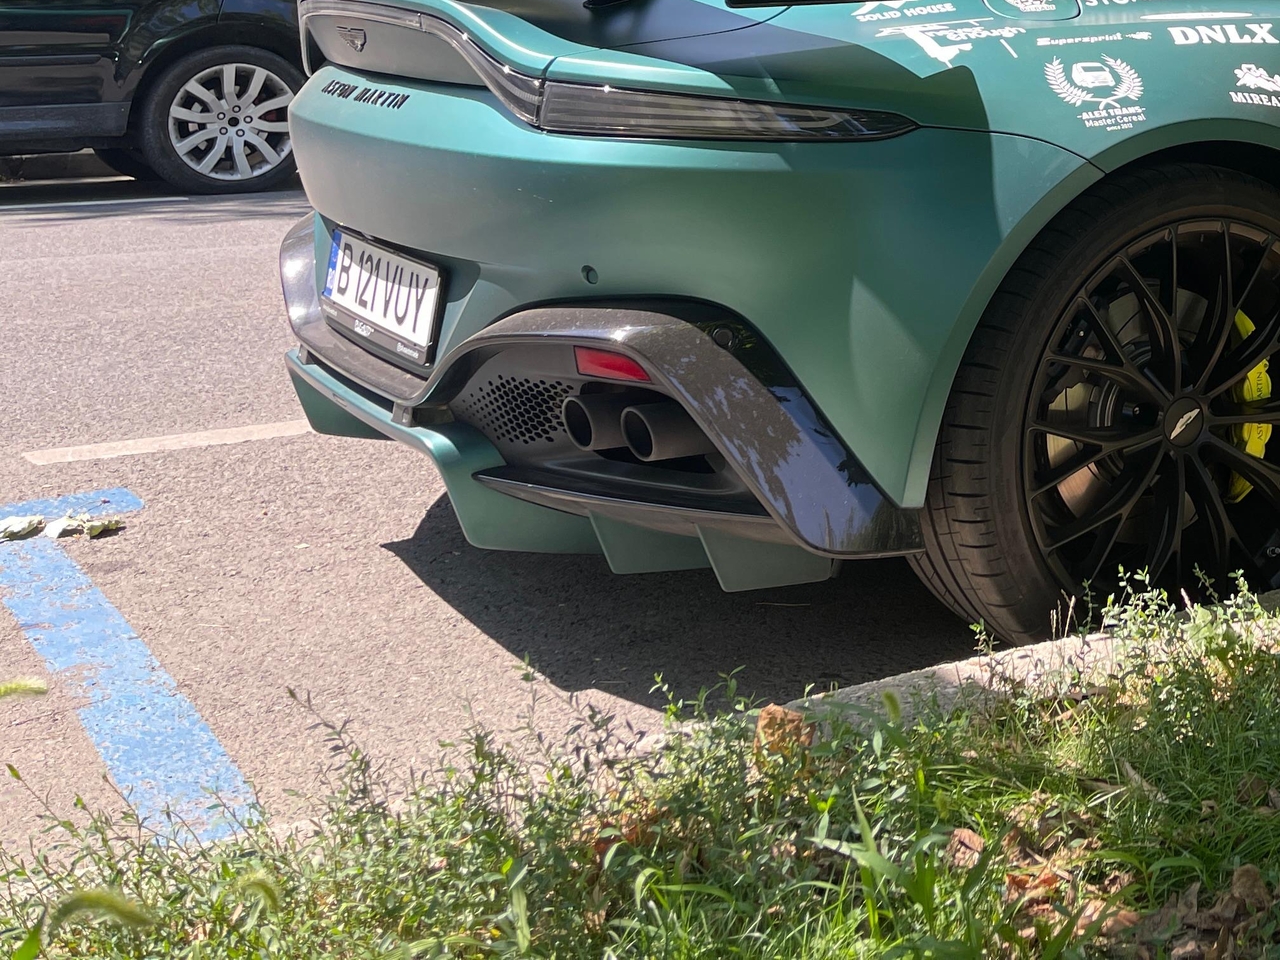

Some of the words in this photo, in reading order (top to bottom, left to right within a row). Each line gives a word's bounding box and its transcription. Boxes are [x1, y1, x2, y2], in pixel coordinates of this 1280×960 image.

[856, 11, 901, 22] SOLID
[903, 2, 956, 17] HOUSE
[1037, 32, 1122, 45] Supersprint
[1167, 23, 1279, 45] DNLX
[354, 87, 410, 109] MARTIN
[1084, 117, 1115, 128] Master
[1116, 113, 1146, 124] Cereal
[337, 243, 353, 296] B
[355, 250, 382, 312] 121
[383, 261, 429, 334] VUY
